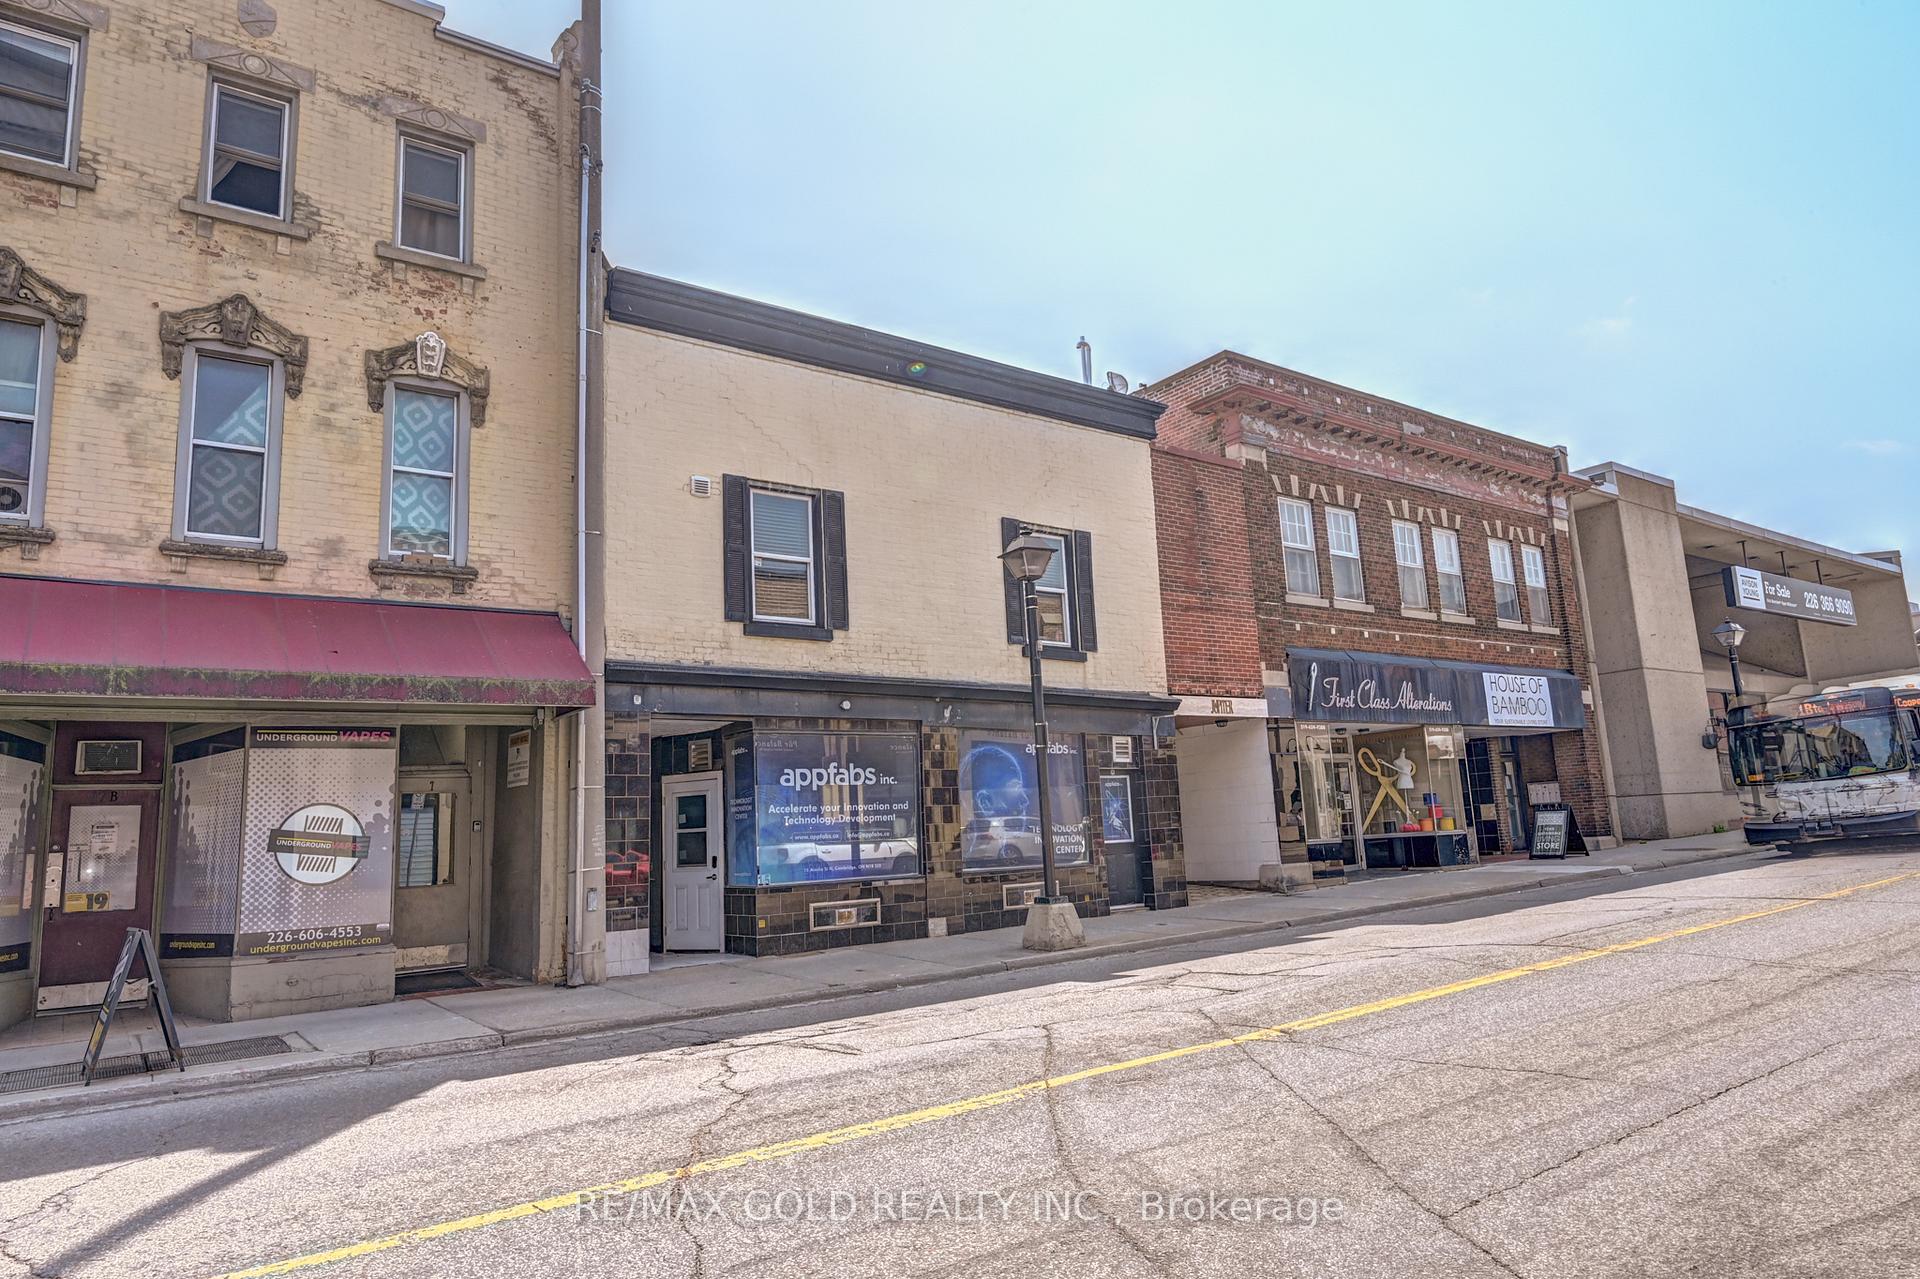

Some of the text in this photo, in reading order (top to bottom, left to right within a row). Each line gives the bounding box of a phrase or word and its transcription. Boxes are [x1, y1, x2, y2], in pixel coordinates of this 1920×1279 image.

[1764, 581, 1791, 598] For Sale
[1804, 591, 1819, 609] 226
[1820, 595, 1835, 612] 366
[1489, 675, 1543, 694] HOUSE OF
[1321, 677, 1452, 711] First Class Alterations
[1491, 696, 1547, 716] BAMBOO
[256, 731, 390, 742] UNDERGROUND VAPES
[1025, 742, 1069, 756] apfabs
[780, 762, 898, 791] appfabs inc.
[768, 801, 909, 815] Accelerate your Innovation and
[784, 813, 896, 825] Technology Development
[1029, 823, 1083, 833] TENOLOGY
[276, 840, 361, 851] UNDERGROUND VAPES
[1034, 834, 1082, 844] INVATION
[1056, 845, 1083, 854] CENTER
[86, 893, 109, 909] 19
[267, 926, 362, 943] 226-606-4553
[250, 937, 381, 954] undergroundvapesinc.com
